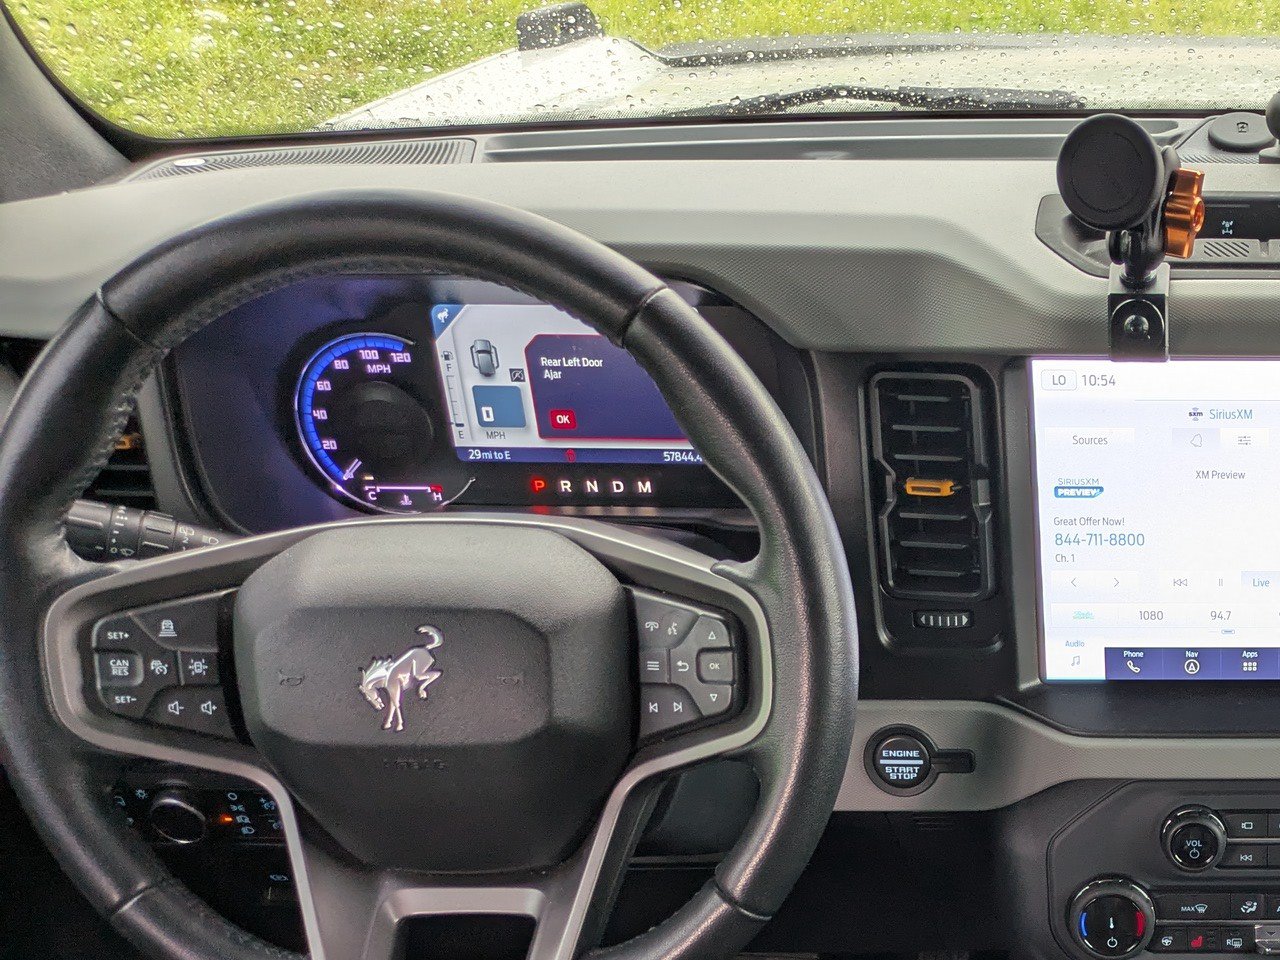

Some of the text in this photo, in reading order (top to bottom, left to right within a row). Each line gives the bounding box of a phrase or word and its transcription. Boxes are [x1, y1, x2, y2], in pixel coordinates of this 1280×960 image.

[360, 351, 379, 360] 100
[391, 353, 411, 362] 120
[334, 361, 349, 370] 80
[540, 357, 603, 367] Rear Left Door
[367, 365, 392, 373] MPH
[446, 364, 452, 372] F
[544, 370, 562, 380] Ajar
[1052, 375, 1066, 386] LO
[1081, 375, 1116, 386] 10:54
[316, 382, 331, 391] 60
[313, 410, 328, 419] 40
[1209, 408, 1253, 420] SiriusXM
[556, 415, 570, 424] OK
[458, 431, 464, 439] E
[486, 431, 506, 440] MPH
[1072, 435, 1108, 445] Sources
[322, 441, 337, 450] 20
[493, 450, 504, 460] to
[505, 451, 511, 459] E
[1195, 470, 1246, 480] XM Preview
[534, 480, 652, 493] P R N D M
[368, 491, 377, 501] C
[1057, 487, 1099, 496] PREVIEW
[433, 492, 442, 501] H
[1053, 517, 1125, 526] Great Offer Now!
[1054, 533, 1145, 546] 844-711-8800
[1055, 553, 1069, 563] Ch.
[1252, 577, 1270, 587] Live
[1139, 610, 1164, 621] 1080
[1210, 610, 1232, 621] 94.7
[1123, 650, 1144, 658] Phone
[1185, 650, 1199, 658] Nav
[1242, 650, 1258, 660] Apps
[109, 659, 129, 667] CAN
[112, 668, 129, 676] RES
[1185, 840, 1203, 848] VOL
